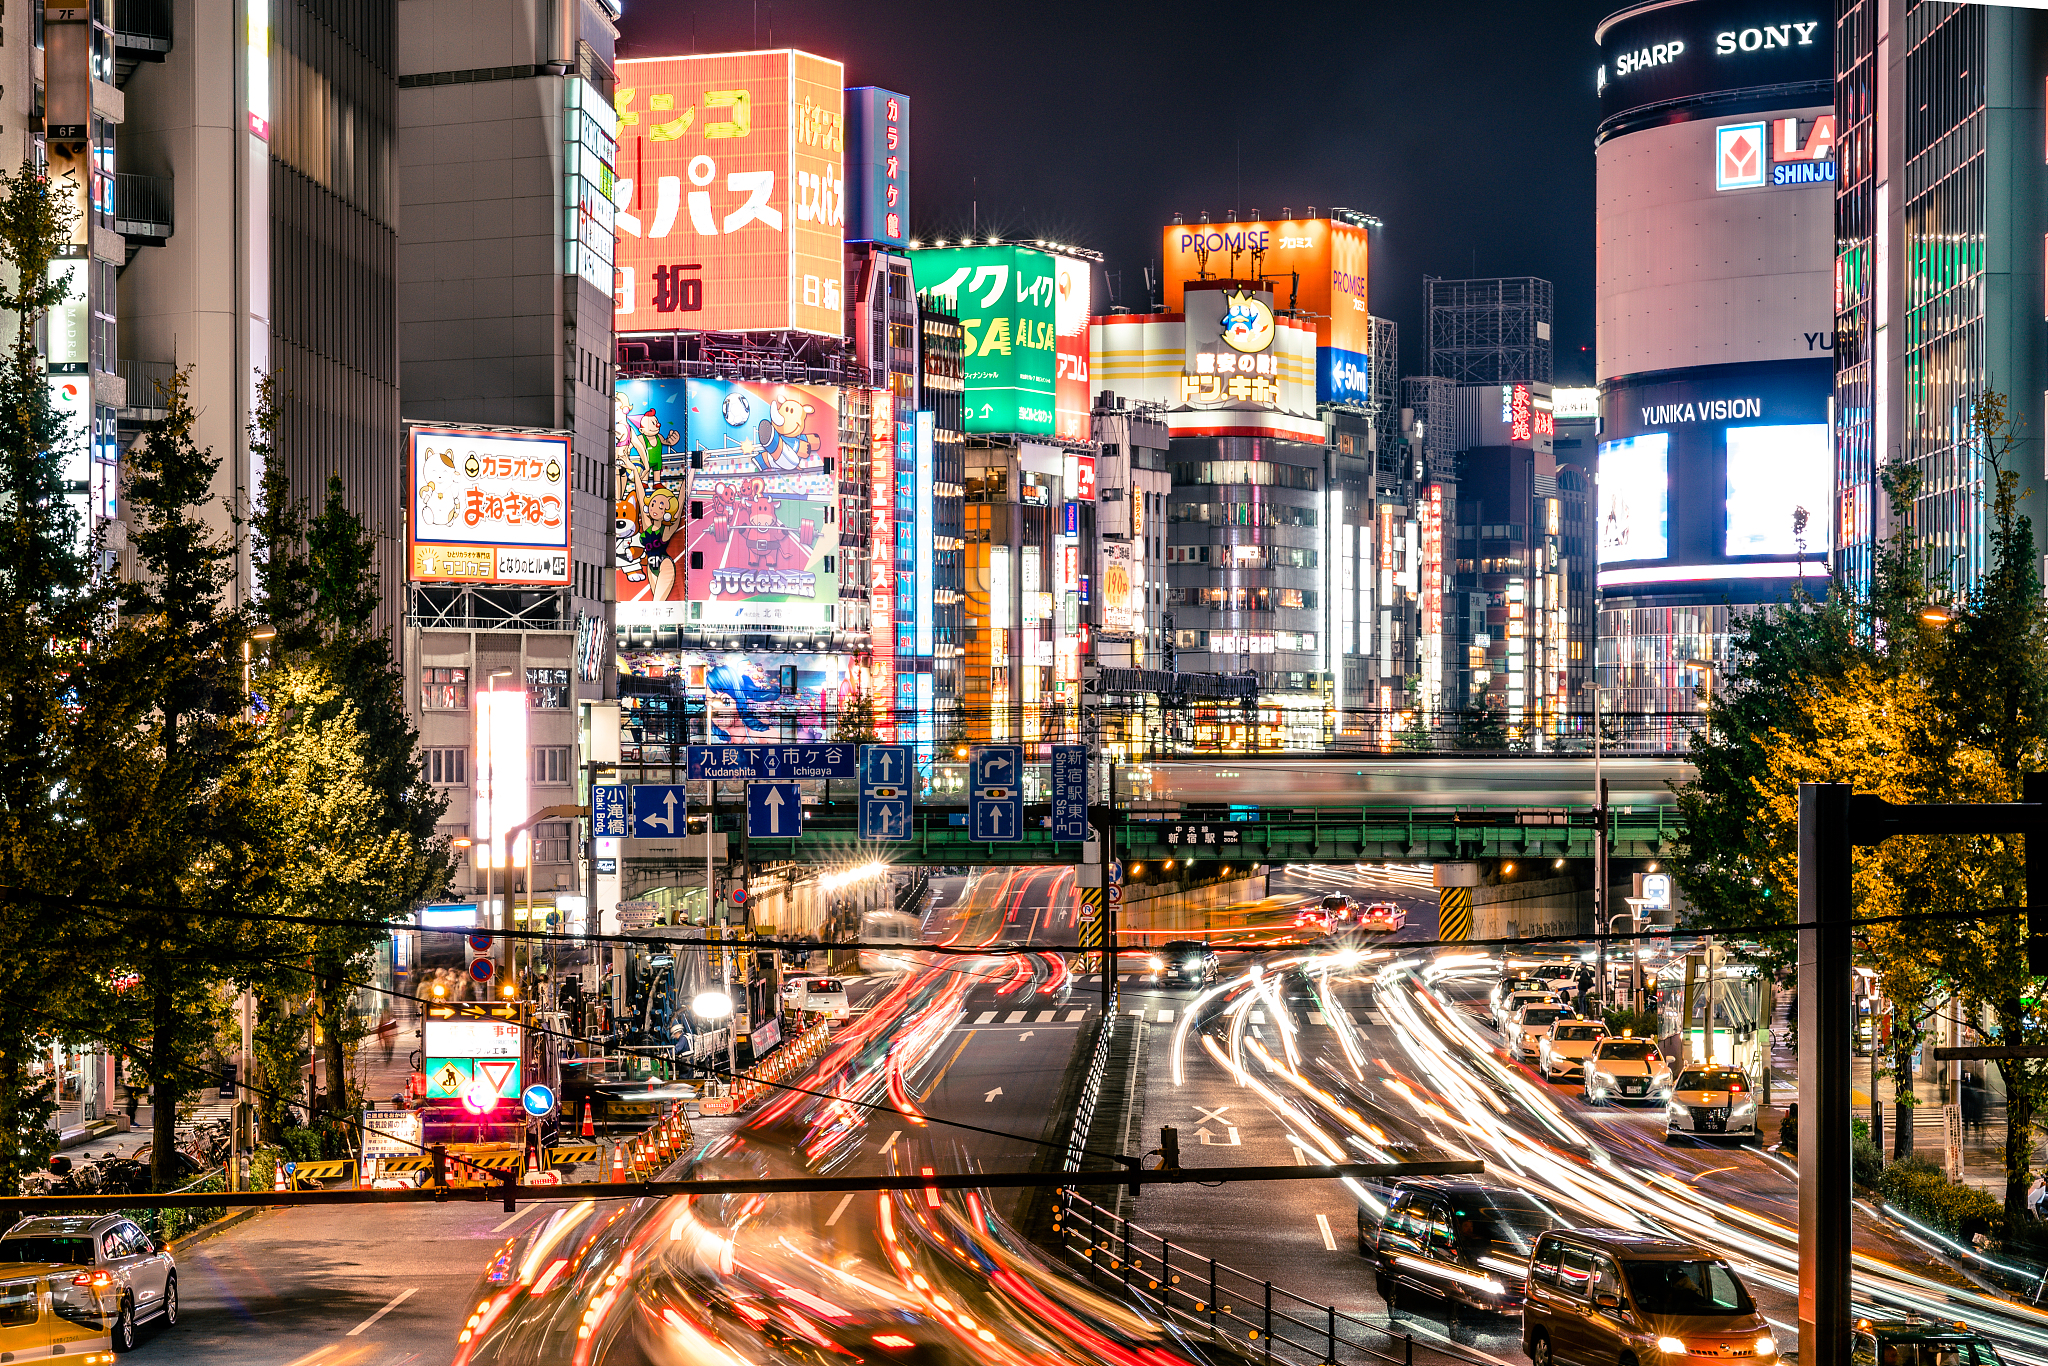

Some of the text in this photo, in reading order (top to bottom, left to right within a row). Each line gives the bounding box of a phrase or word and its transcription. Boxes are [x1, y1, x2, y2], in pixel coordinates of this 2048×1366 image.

[59, 10, 75, 19] 7F
[1716, 21, 1817, 55] SONY
[1617, 41, 1684, 76] SHARP
[60, 126, 75, 136] 6F
[886, 98, 901, 239] カラオケ館
[1182, 230, 1313, 253] PROMISE プロミス
[917, 265, 1009, 309] イク
[1016, 270, 1054, 309] レイク
[1333, 269, 1365, 298] PROMISE
[67, 308, 77, 358] MADRE
[1016, 318, 1054, 353] ALSA
[62, 363, 76, 372] 4F
[1057, 353, 1088, 382] アコム
[1345, 365, 1366, 393] 50m
[1641, 398, 1761, 425] YUNIKA VISION
[482, 456, 544, 479] カラオケ
[464, 486, 560, 527] まねきねこ
[443, 561, 491, 576] ワンカラ
[447, 551, 491, 560] ひとりカラオケ専門店
[499, 557, 565, 575] となりのビル 4F
[709, 567, 816, 599] JUGGLER
[700, 748, 761, 766] 九段下
[704, 766, 832, 777] Kudanshita Ichigaya
[1054, 752, 1067, 796] Shinjuku
[595, 787, 606, 811] Otaki
[1067, 749, 1083, 836] 新宿駅東口
[606, 787, 625, 835] 小滝橋
[1168, 832, 1216, 844] 新宿駅
